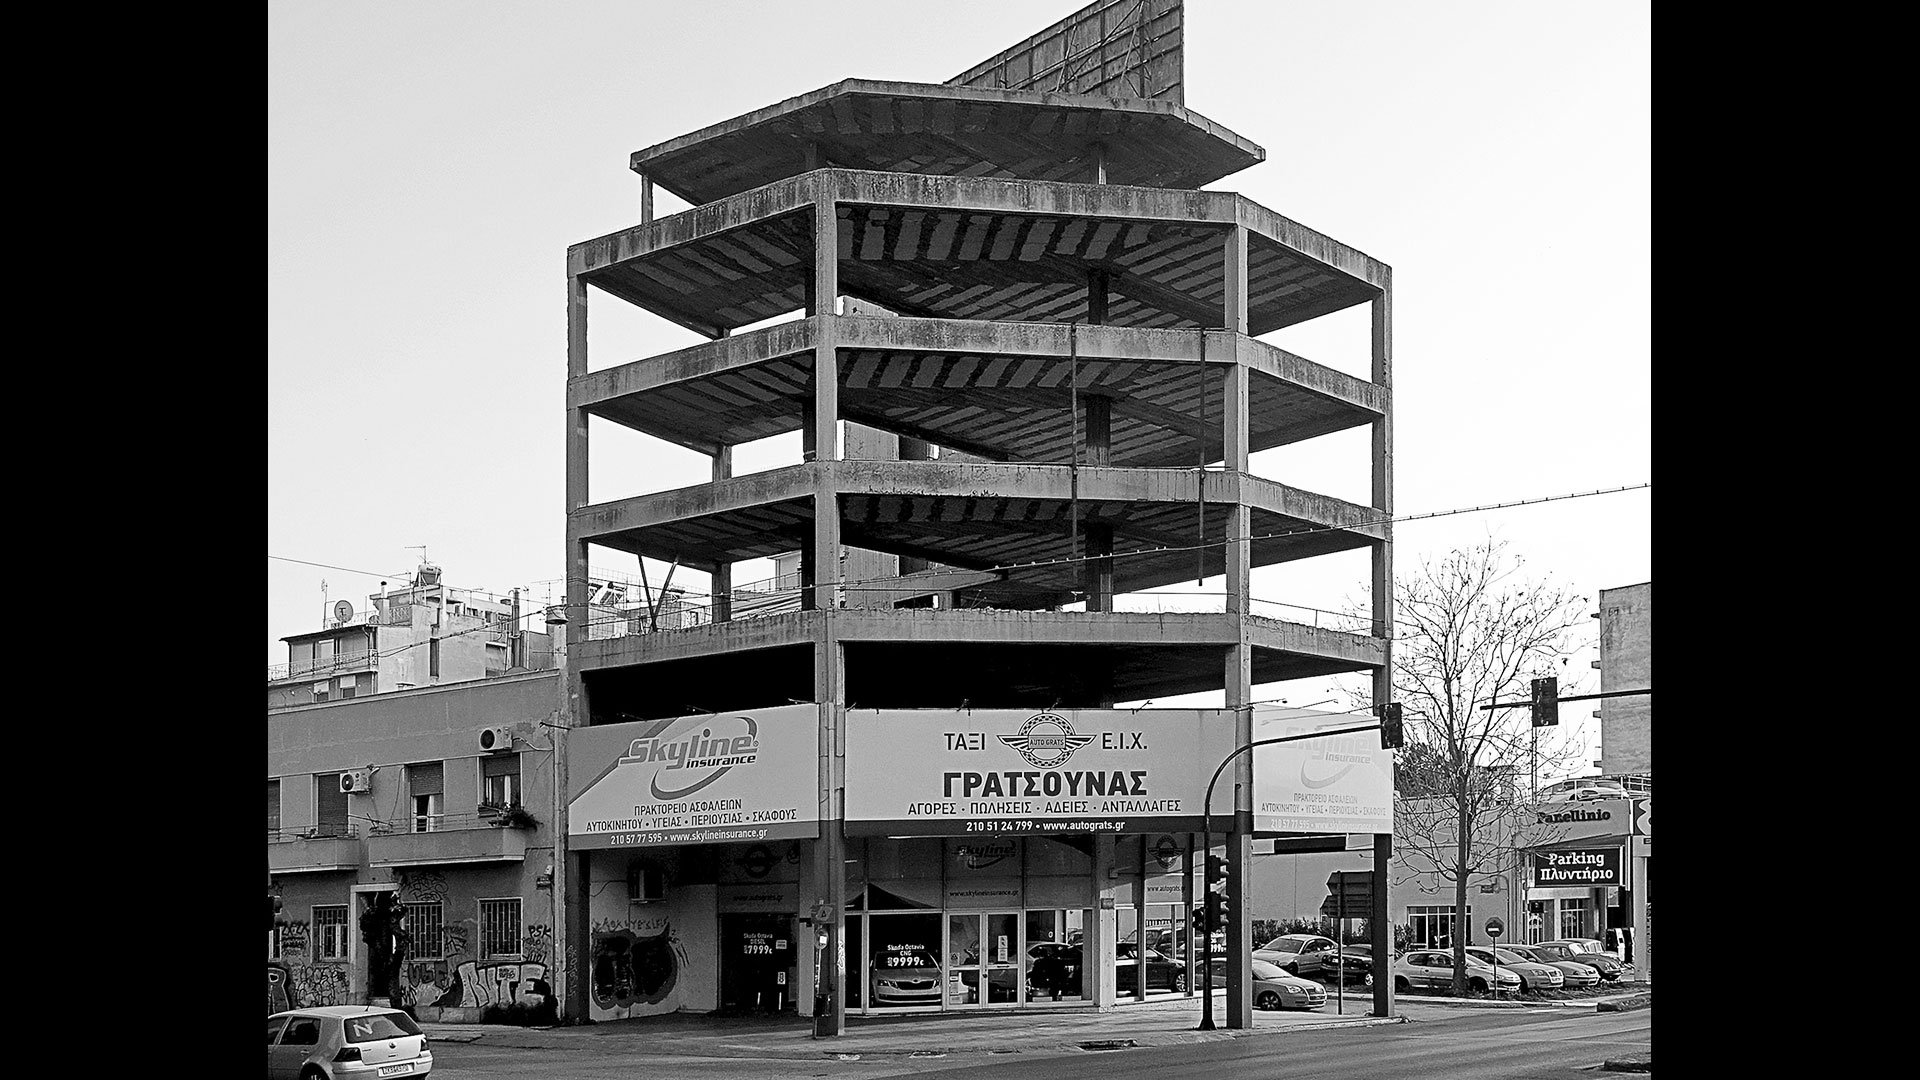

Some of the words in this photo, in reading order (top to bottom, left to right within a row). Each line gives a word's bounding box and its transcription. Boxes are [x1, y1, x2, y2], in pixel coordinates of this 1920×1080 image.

[619, 728, 758, 770] Skyline
[943, 733, 986, 751] ΤΑΞΙ
[1102, 733, 1148, 750] Ε.Ι.Χ.
[686, 755, 756, 769] insurance
[1325, 752, 1371, 764] insurance
[943, 770, 1148, 798] ΓΡΑΤΣΟΥΝΑΣ
[634, 803, 687, 816] ΠΡΑΚΤΟΡΕΙΟ
[689, 799, 742, 813] ΑΣΦΑΛΕΙΩΝ
[908, 802, 957, 816] ΑΓΟΡΕΣ
[970, 802, 1032, 815] ΠΩΛΗΣΕΙΣ
[1044, 801, 1089, 814] ΑΔΕΙΕΣ
[1101, 800, 1182, 813] ΑΝΤΑΛΛΑΓΕΣ
[586, 818, 643, 832] ΑΥΤΟΚΙΝΗΤΟΥ
[652, 816, 682, 829] ΥΓΕΙΑΣ
[691, 812, 743, 826] ΠΕΡΙΟΥΣΙΑΣ
[752, 808, 797, 823] ΣΚΑΦΟΥΣ
[1537, 808, 1611, 824] Panellinio
[966, 821, 984, 832] 210
[985, 821, 998, 831] 51
[1000, 821, 1013, 831] 24
[1015, 820, 1033, 831] 799
[1043, 819, 1126, 833] www.autograts.gr
[610, 835, 625, 845] 210
[626, 835, 635, 844] 57
[637, 834, 647, 844] 77
[648, 833, 662, 843] 595
[670, 828, 767, 843] www.skylineinsurance.gr
[1549, 852, 1605, 866] Parking
[1540, 867, 1614, 882] Πλυντήριο
